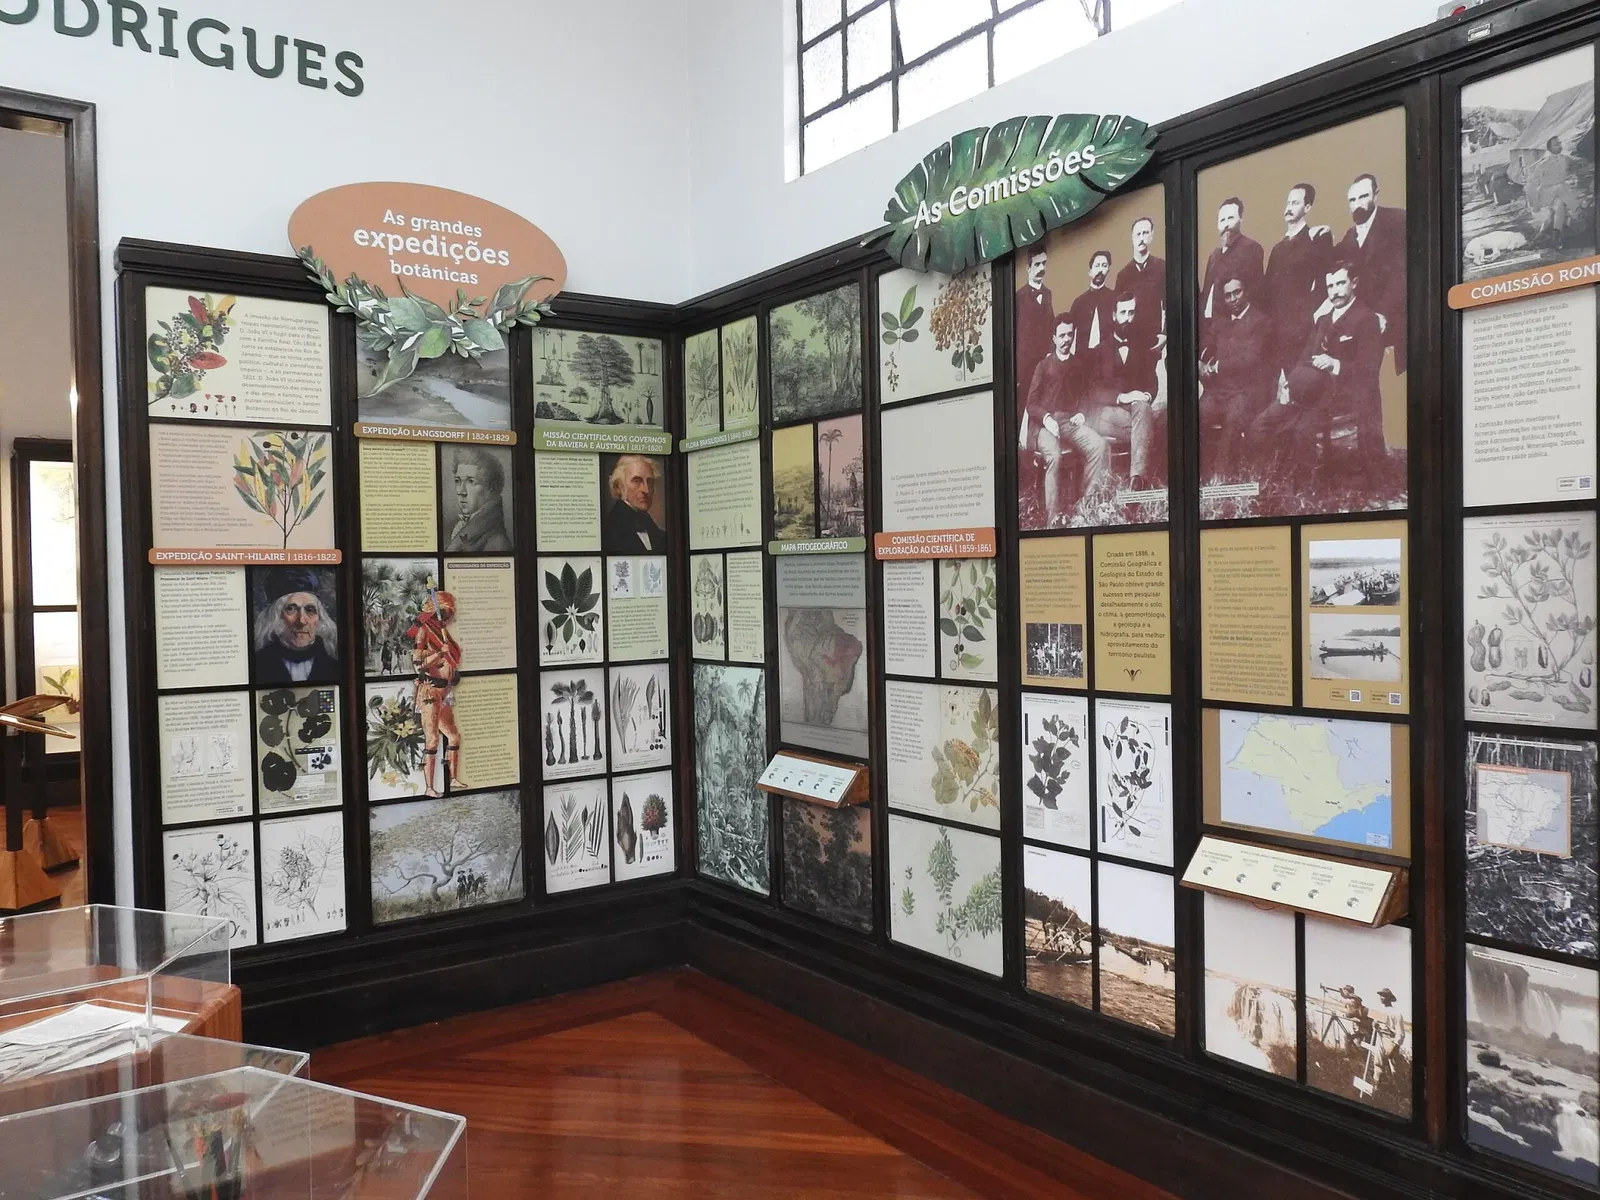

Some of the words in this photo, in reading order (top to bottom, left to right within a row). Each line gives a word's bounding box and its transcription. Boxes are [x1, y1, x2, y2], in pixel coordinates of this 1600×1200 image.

[914, 200, 942, 230] As
[949, 144, 1096, 217] Comissões
[383, 209, 405, 226] As
[411, 216, 482, 238] grandes
[353, 228, 510, 267] expedições
[390, 259, 479, 285] botânicas
[1471, 272, 1554, 299] COMISSÃO
[1478, 419, 1503, 428] Comissão
[362, 426, 410, 437] EXPEDIÇÃO
[412, 427, 465, 439] LANGSDORFF
[471, 433, 510, 442] 1824-1829
[543, 431, 570, 440] MISSÃO
[572, 432, 612, 442] CIENTÍFICA
[613, 434, 628, 443] DOS
[628, 435, 667, 444] GOVERNOS
[558, 440, 588, 449] BAVIERA
[631, 444, 663, 452] 1817-1820
[685, 440, 700, 449] FLORA
[892, 534, 925, 544] COMISSÃO
[926, 534, 964, 543] CIENTÍFICA
[965, 533, 976, 542] DE
[781, 543, 797, 552] MAPA
[797, 541, 848, 551] FITOGEOGRÁFICO
[878, 545, 920, 556] EXPLORAÇÃO
[931, 544, 953, 554] CEARÁ
[959, 544, 992, 553] 1859-1861
[156, 552, 213, 562] EXPEDIÇÃO
[215, 553, 286, 561] SAINT-HILAIRE
[293, 553, 337, 561] 1816-1822
[1144, 580, 1165, 588] grande
